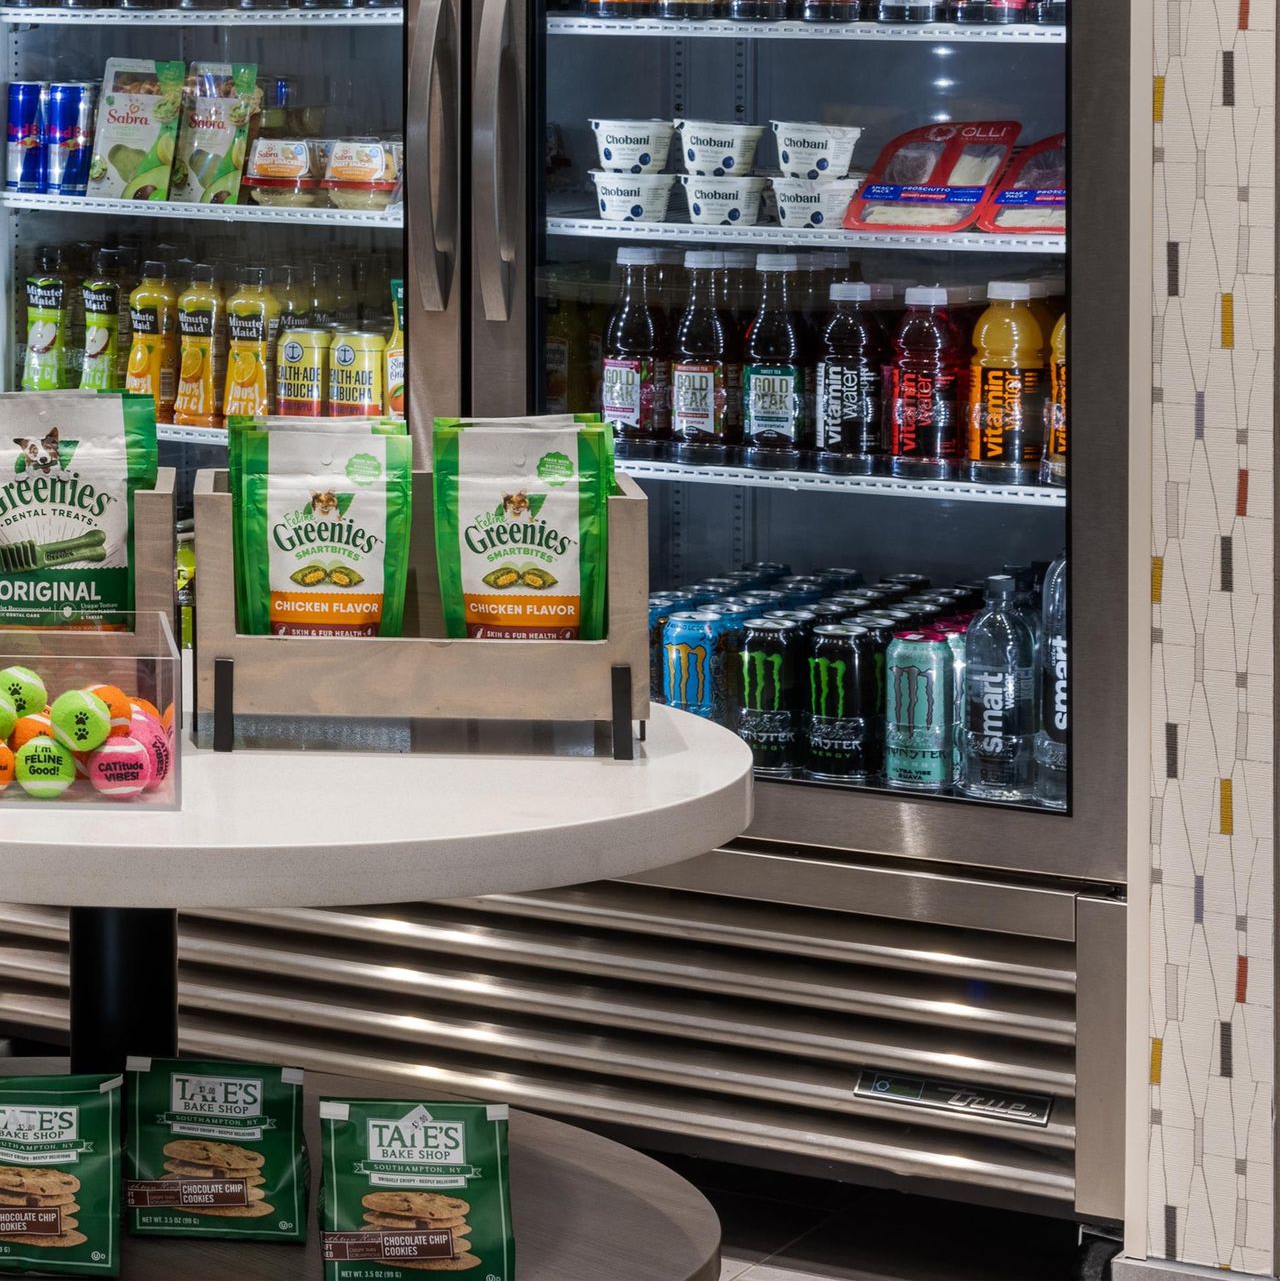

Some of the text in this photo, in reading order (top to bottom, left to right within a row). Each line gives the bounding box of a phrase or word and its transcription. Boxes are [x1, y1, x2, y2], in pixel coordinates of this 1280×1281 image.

[107, 108, 149, 125] Sabra
[690, 136, 733, 148] Chobani
[695, 190, 739, 200] Chobani
[984, 371, 1004, 458] vitamin
[4, 508, 94, 527] DENTAL TREATS
[273, 519, 378, 554] Greenies
[295, 545, 360, 561] SMARTBITES
[275, 599, 378, 614] CHICKEN FLAVOR
[25, 754, 62, 766] FELINE
[29, 764, 59, 777] Good!
